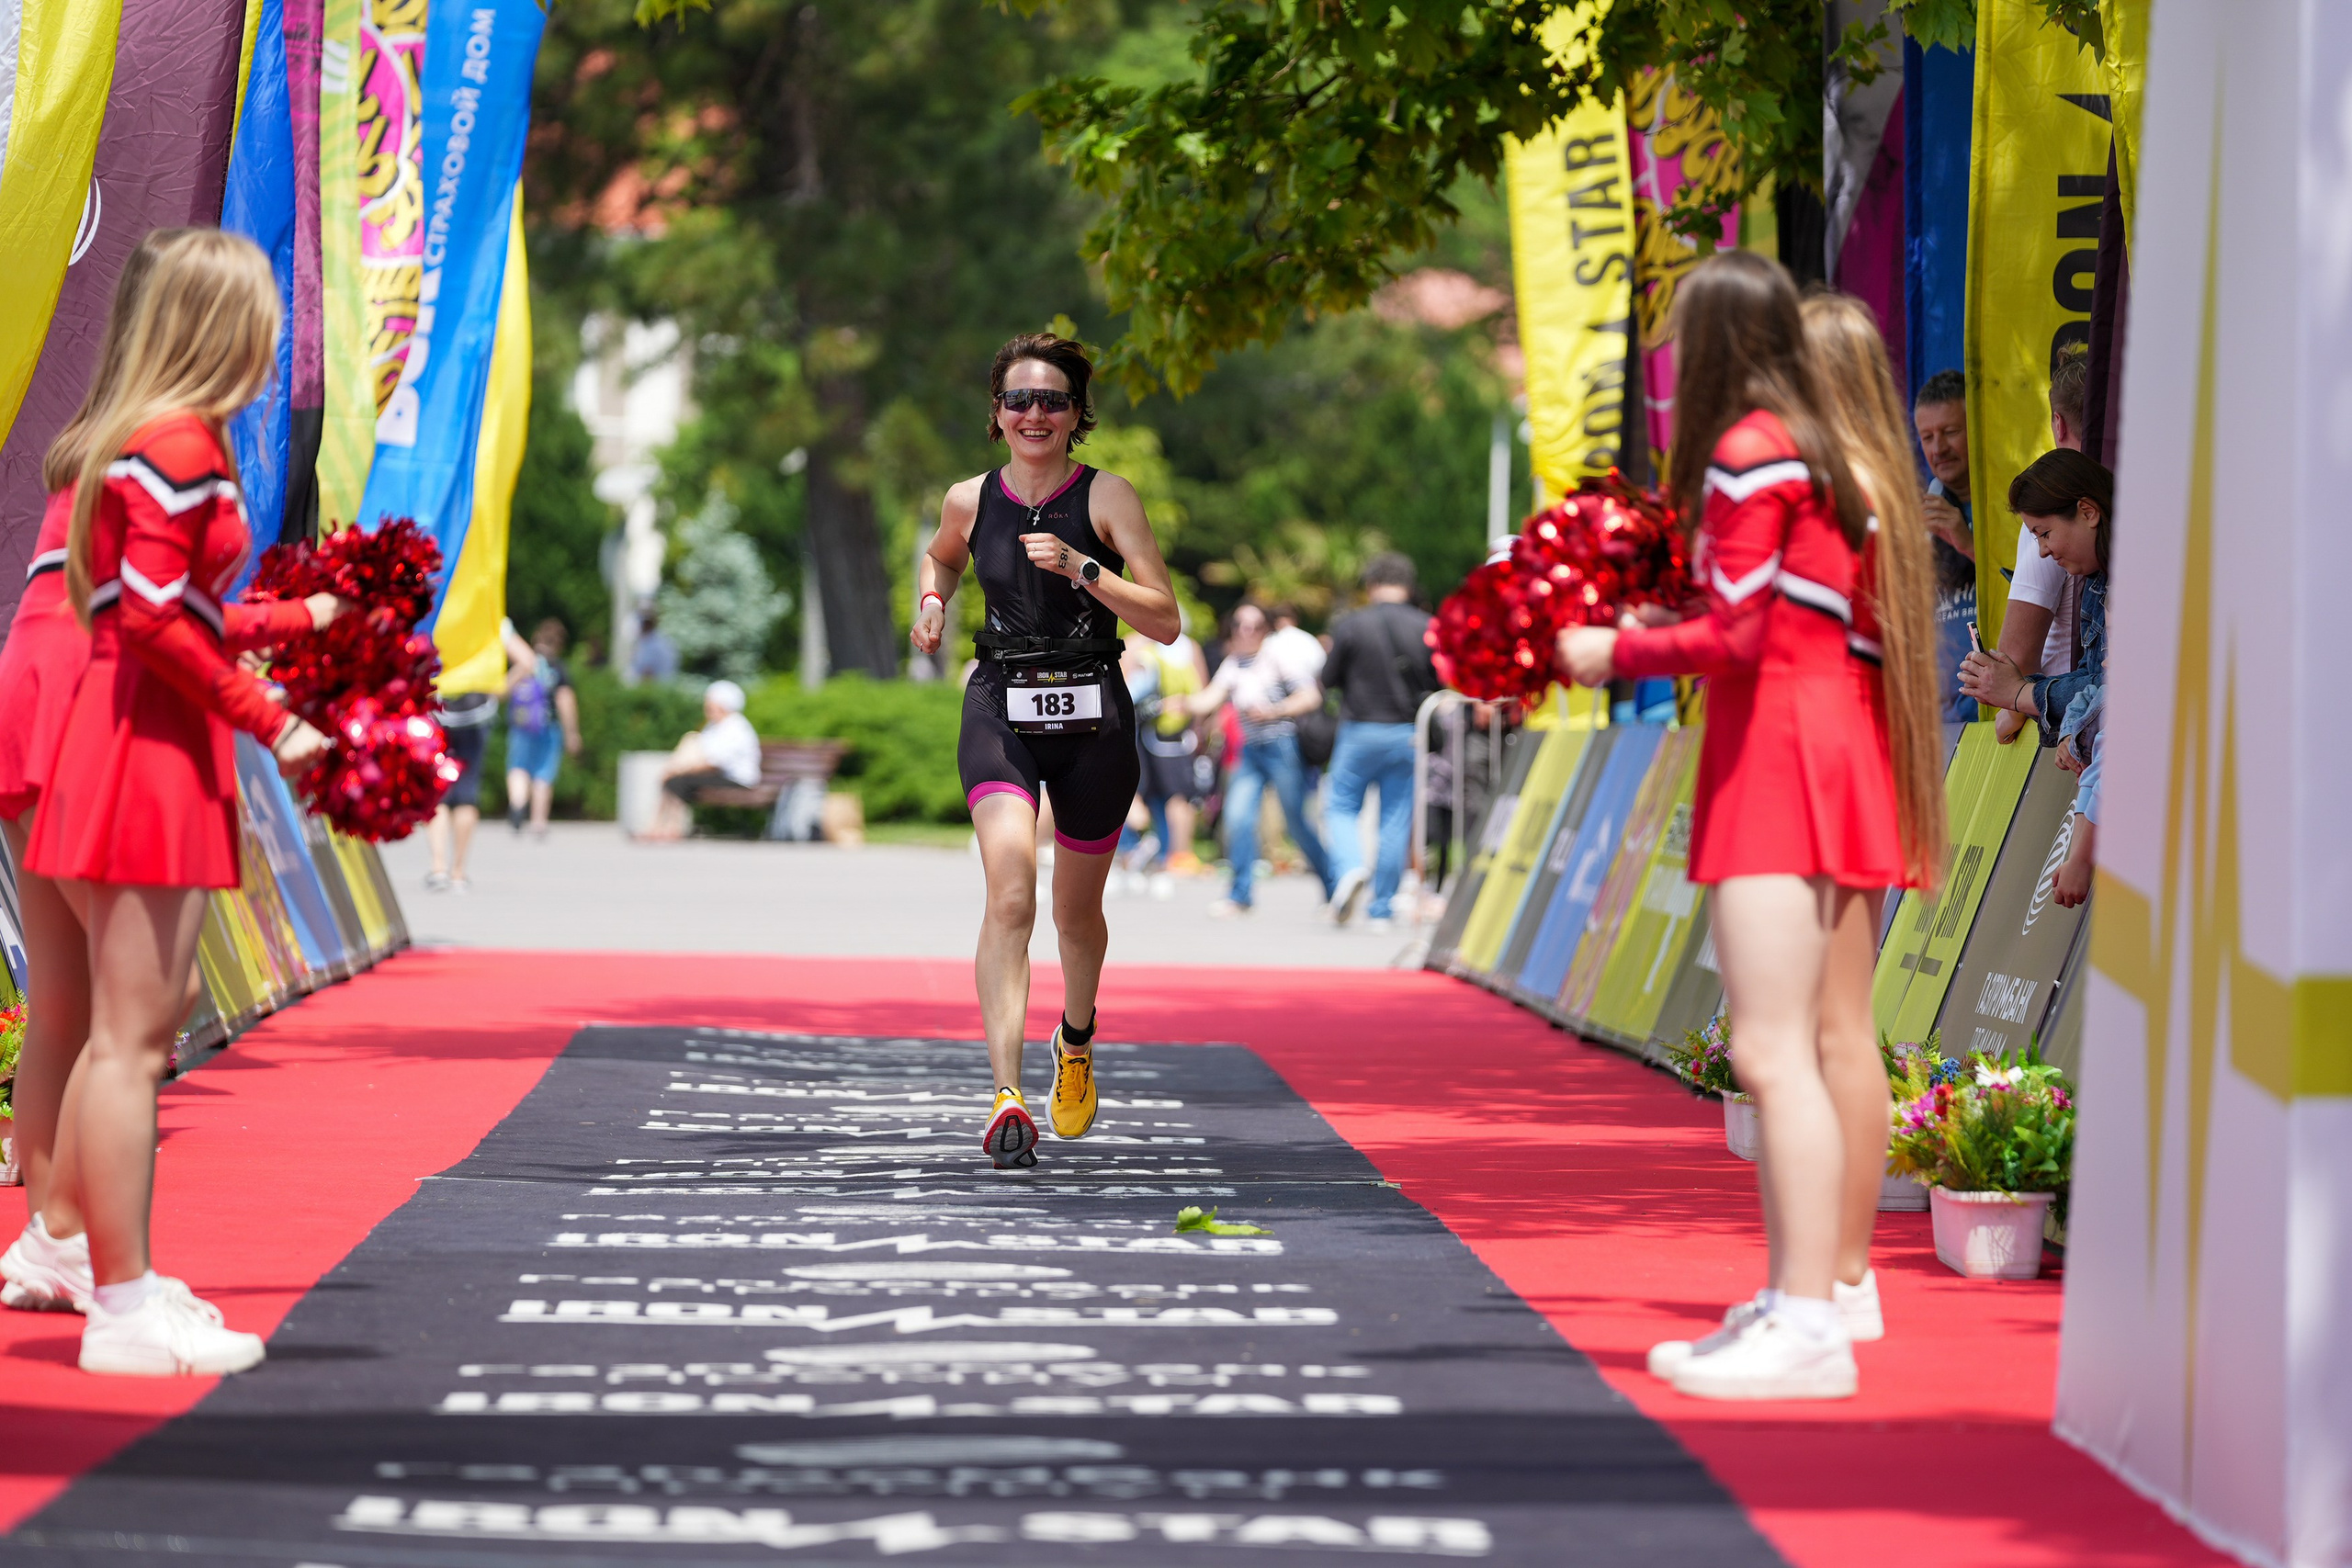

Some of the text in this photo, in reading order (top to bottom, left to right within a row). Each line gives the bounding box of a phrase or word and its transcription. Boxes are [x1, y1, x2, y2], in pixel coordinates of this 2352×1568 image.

[424, 8, 496, 266] СТРАХОВОЙ ДОМ
[1566, 132, 1634, 288] STAR
[1031, 693, 1075, 716] 183
[1045, 722, 1064, 730] IRINA
[973, 1185, 1238, 1195] STAR
[554, 1232, 1283, 1252] IRON STAR
[508, 1299, 1340, 1324] IRON STAR
[442, 1391, 1404, 1416] IRON STAR
[345, 1495, 792, 1536] IRON
